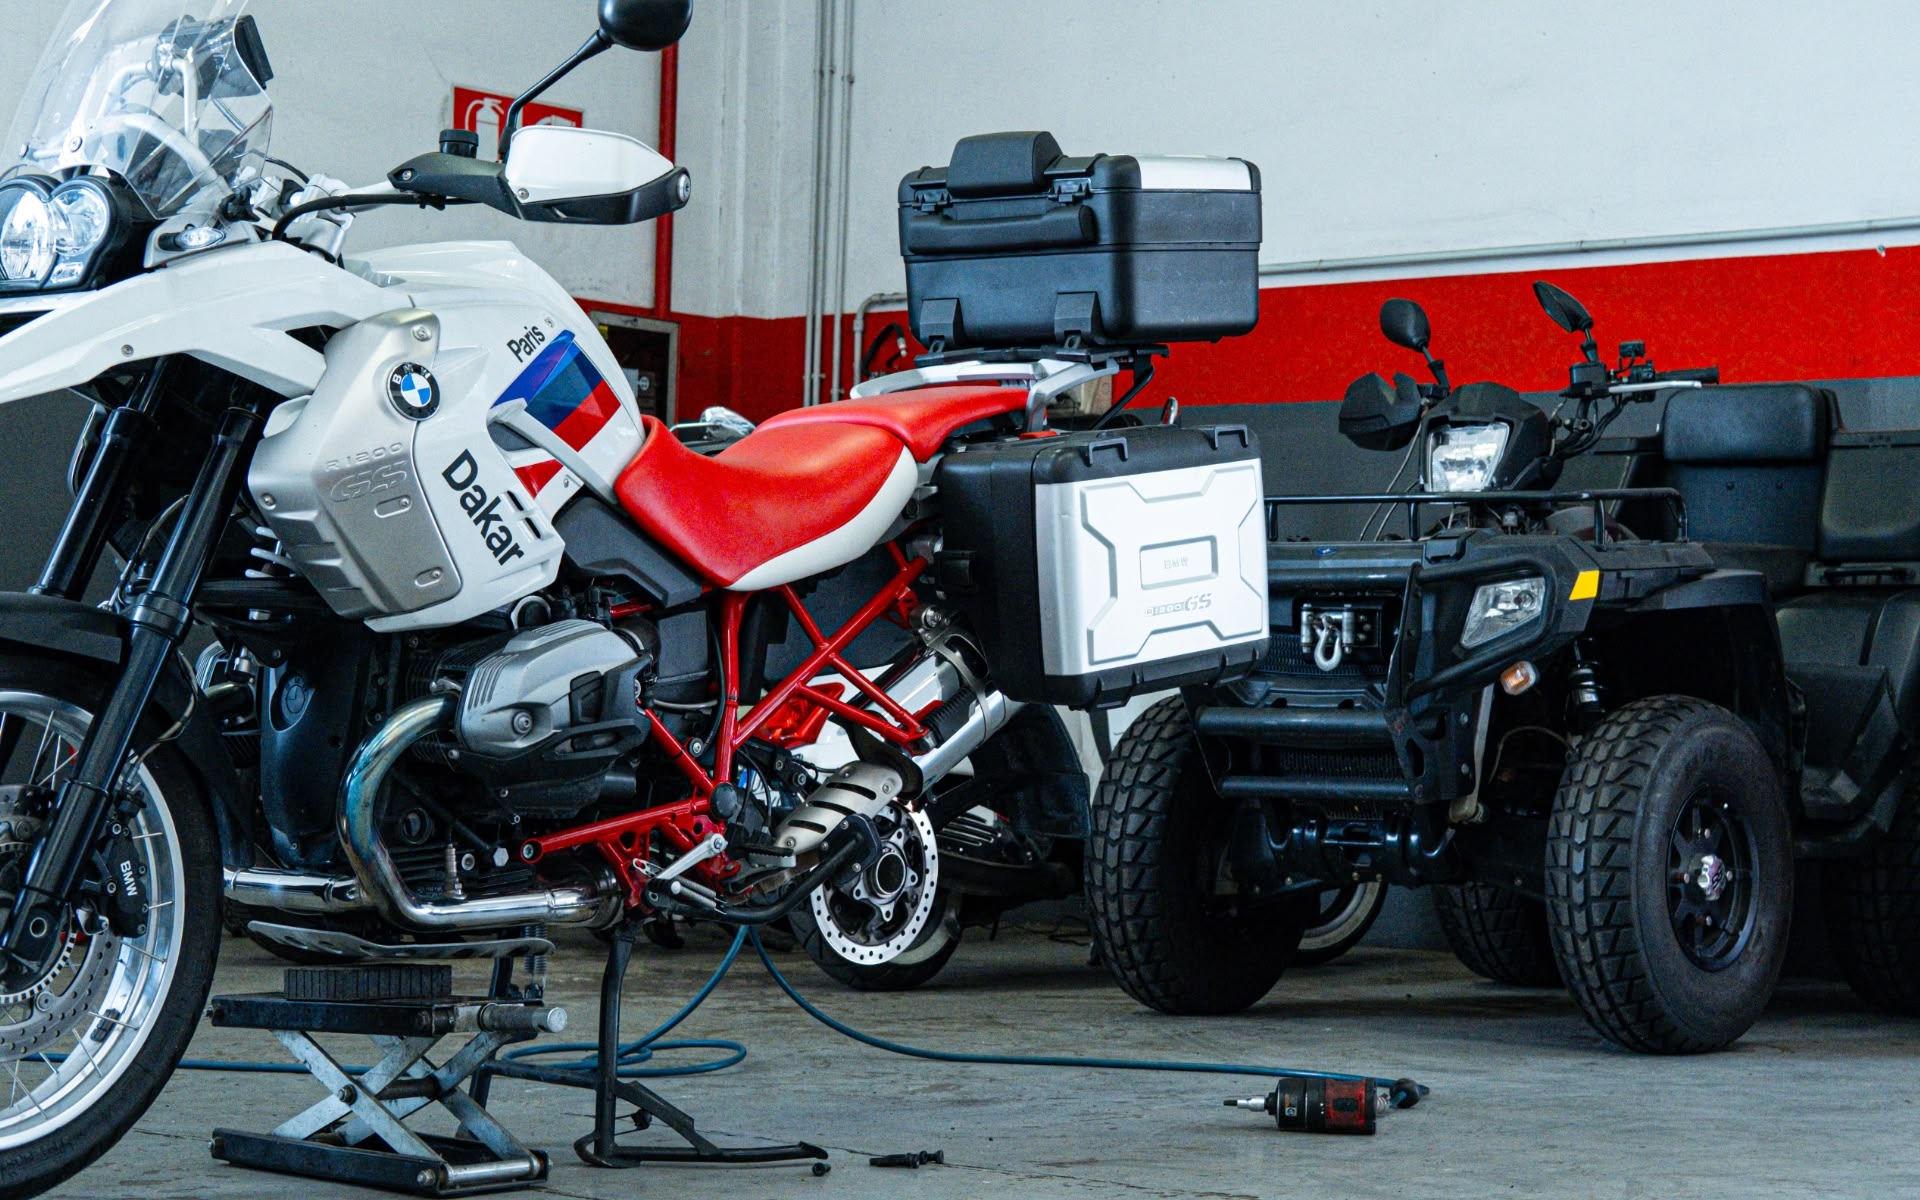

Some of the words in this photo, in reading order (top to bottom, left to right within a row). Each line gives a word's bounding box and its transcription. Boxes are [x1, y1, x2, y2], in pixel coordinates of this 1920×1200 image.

[506, 325, 546, 363] Paris
[392, 363, 431, 385] BMW
[330, 460, 407, 503] GS
[441, 448, 525, 566] Dakar
[120, 860, 138, 896] BMW
